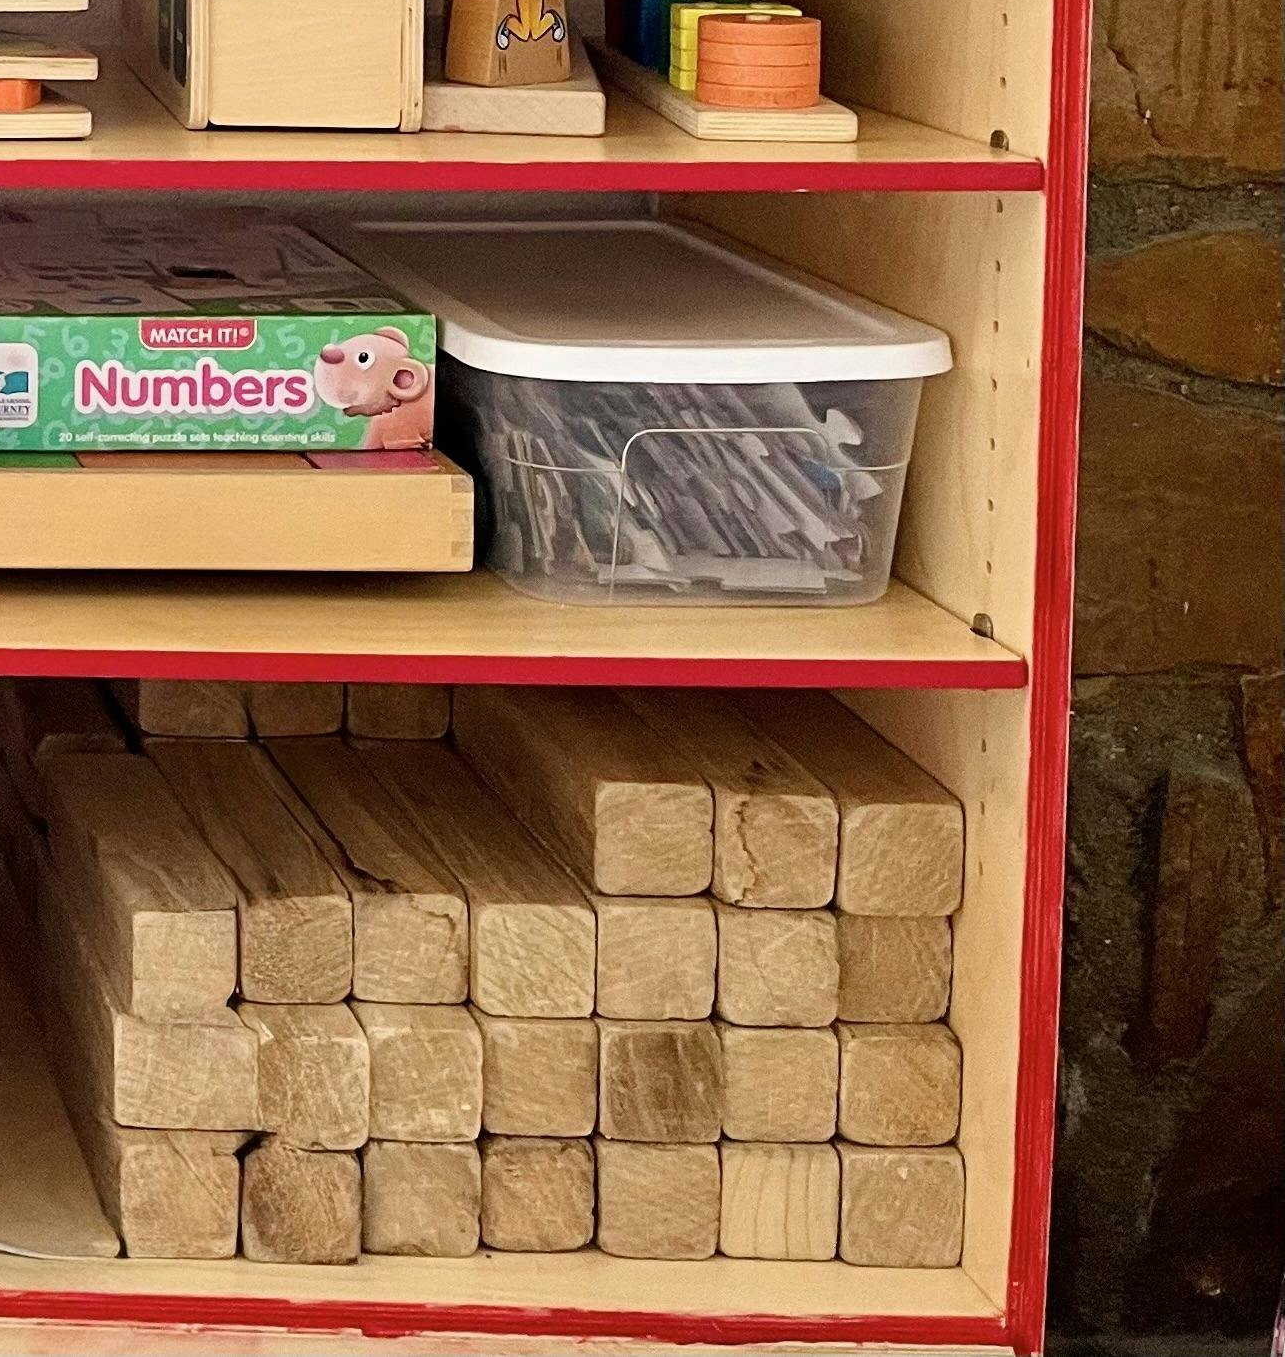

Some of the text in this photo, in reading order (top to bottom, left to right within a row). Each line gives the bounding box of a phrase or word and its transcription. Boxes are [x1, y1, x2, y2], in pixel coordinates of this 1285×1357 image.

[149, 327, 213, 344] MATCH
[80, 363, 308, 408] Numbers
[58, 432, 73, 443] 20
[152, 432, 188, 445] puzzle
[213, 432, 259, 445] teaching
[261, 432, 308, 445] counting
[311, 431, 336, 443] skills
